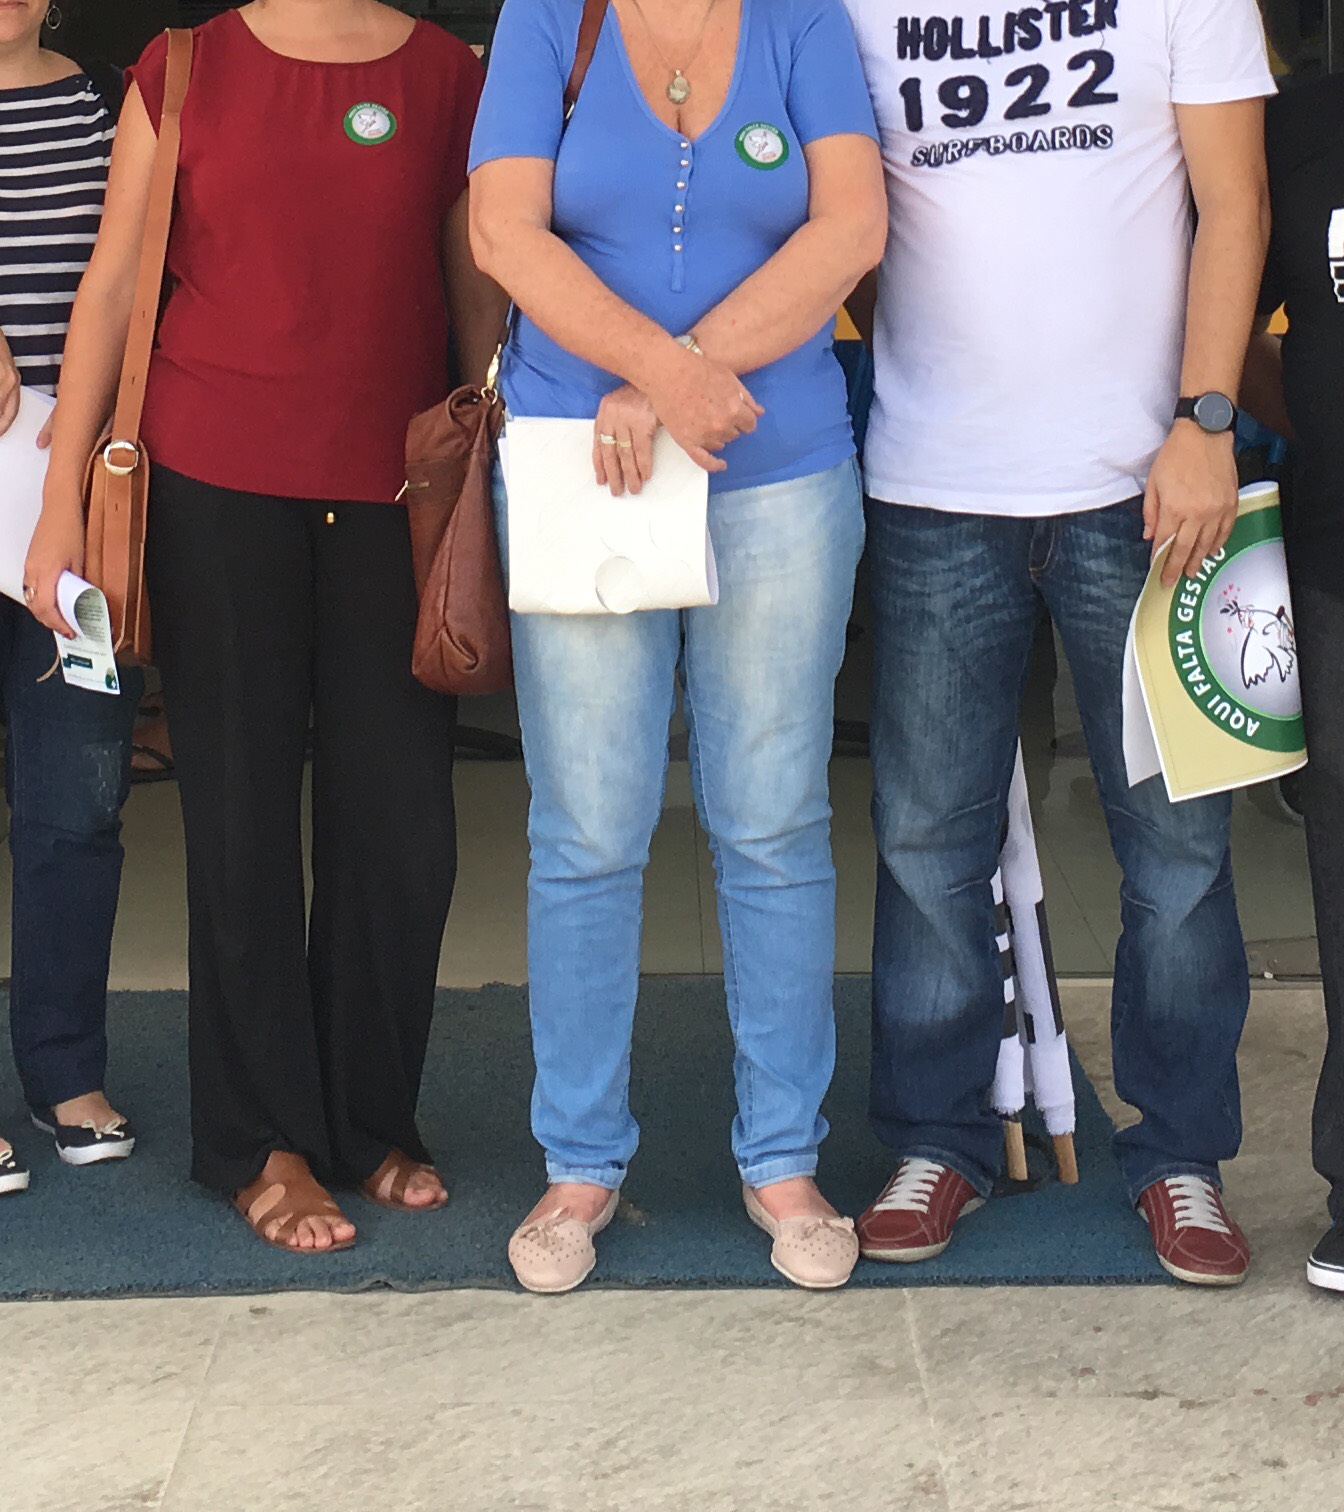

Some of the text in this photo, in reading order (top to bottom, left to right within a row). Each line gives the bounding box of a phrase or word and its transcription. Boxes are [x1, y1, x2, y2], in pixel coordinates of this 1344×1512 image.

[899, 49, 1119, 133] 1922
[910, 124, 1113, 168] SURFBOARDS
[1175, 629, 1211, 696] FALTA
[1207, 694, 1261, 737] AQUI
